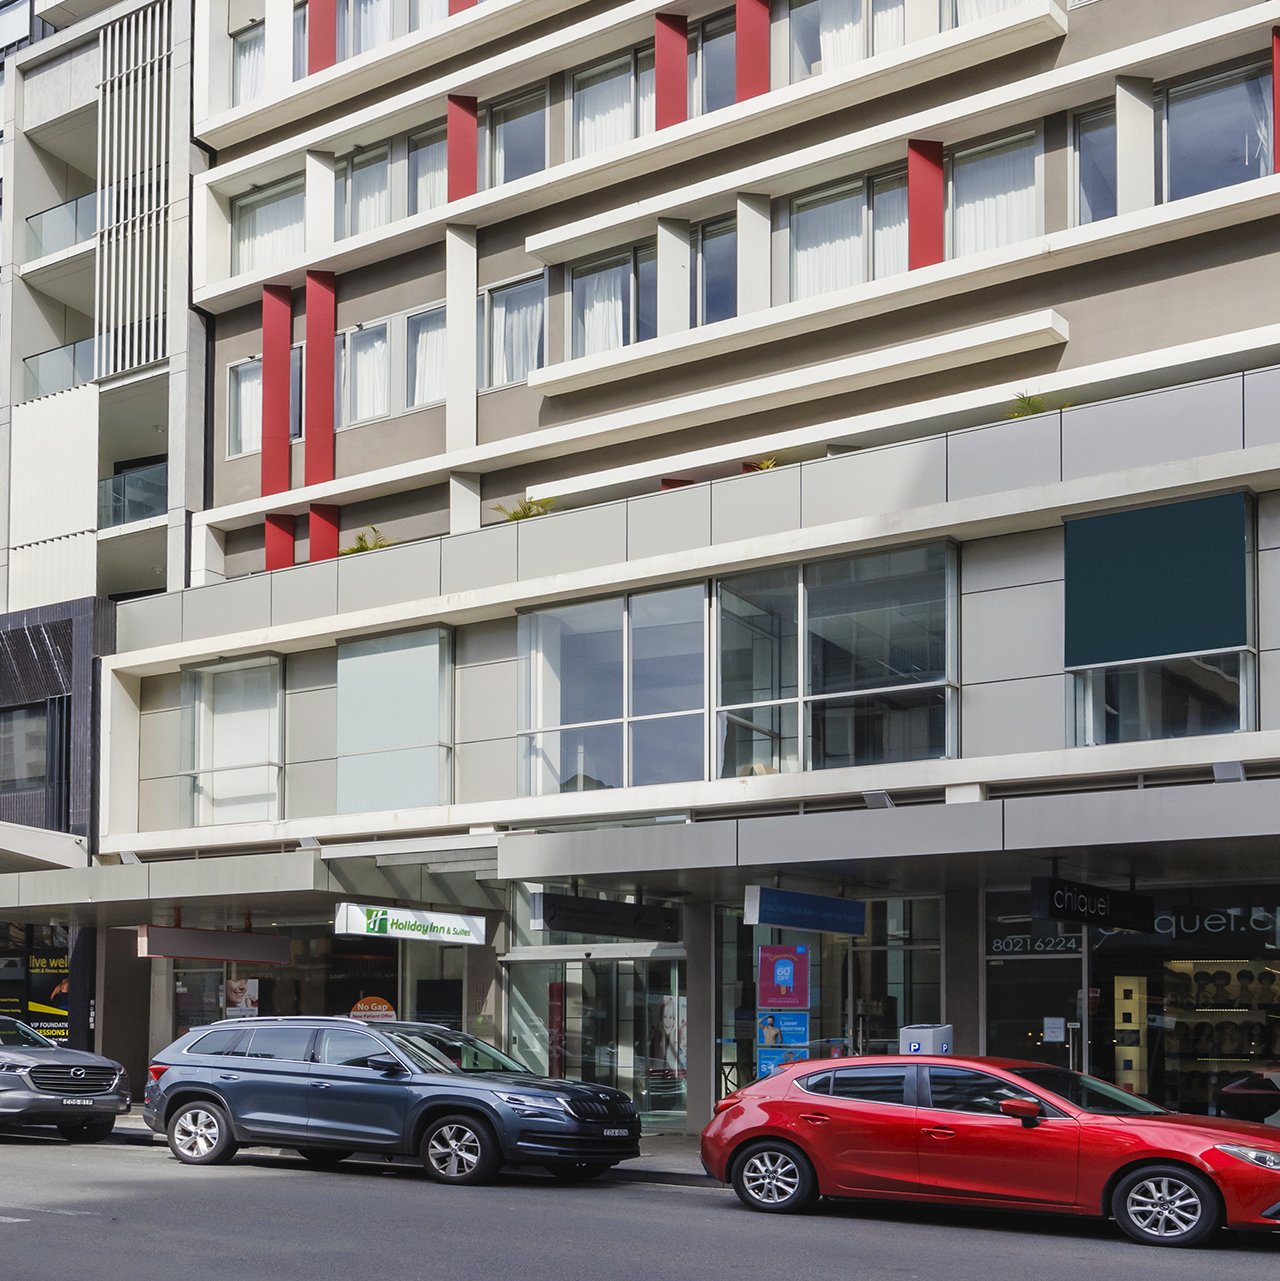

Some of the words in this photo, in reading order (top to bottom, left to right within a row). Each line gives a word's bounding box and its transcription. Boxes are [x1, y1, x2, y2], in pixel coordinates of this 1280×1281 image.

[1054, 886, 1110, 916] chiquel
[452, 927, 471, 937] Suites
[992, 937, 1076, 952] 80216224
[29, 954, 47, 968] live
[49, 954, 68, 968] wel
[776, 967, 790, 976] 60
[357, 1003, 369, 1011] No
[370, 1003, 388, 1012] Gap
[911, 1043, 919, 1052] P
